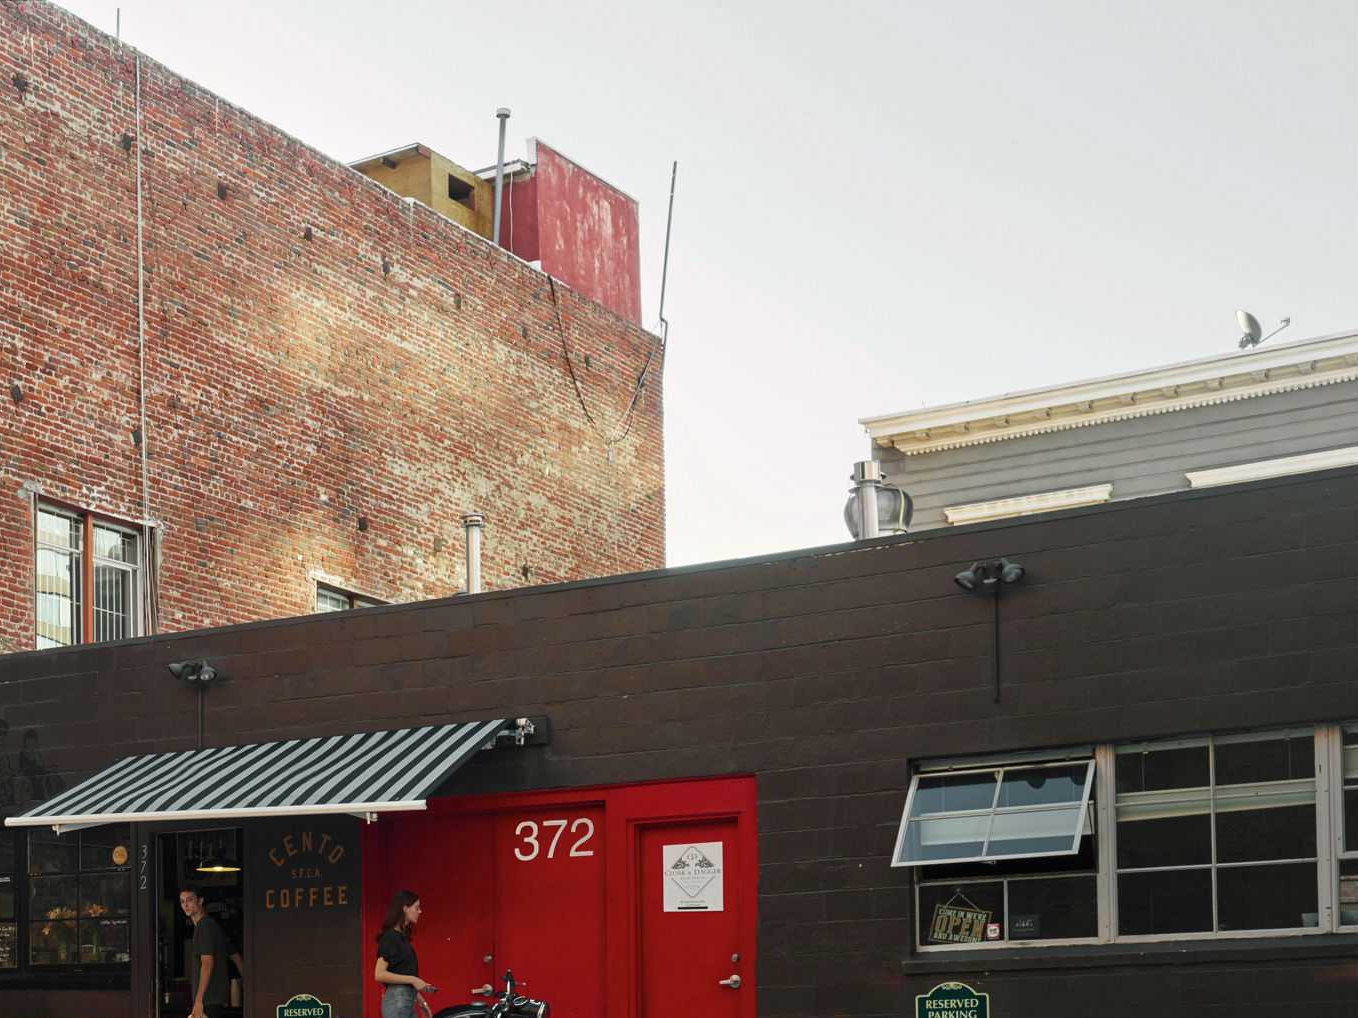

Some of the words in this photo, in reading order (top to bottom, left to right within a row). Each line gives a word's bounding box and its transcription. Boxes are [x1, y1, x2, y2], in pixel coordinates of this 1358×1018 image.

[513, 817, 595, 862] 372
[268, 831, 344, 867] CENTO
[139, 844, 148, 890] 372
[291, 868, 323, 879] S.F.C.A.
[266, 886, 348, 909] COFFEE
[938, 908, 957, 917] COME
[934, 915, 987, 938] OPEN
[933, 931, 948, 940] AND
[284, 1007, 324, 1017] RESERVED
[925, 998, 979, 1009] RESERVED
